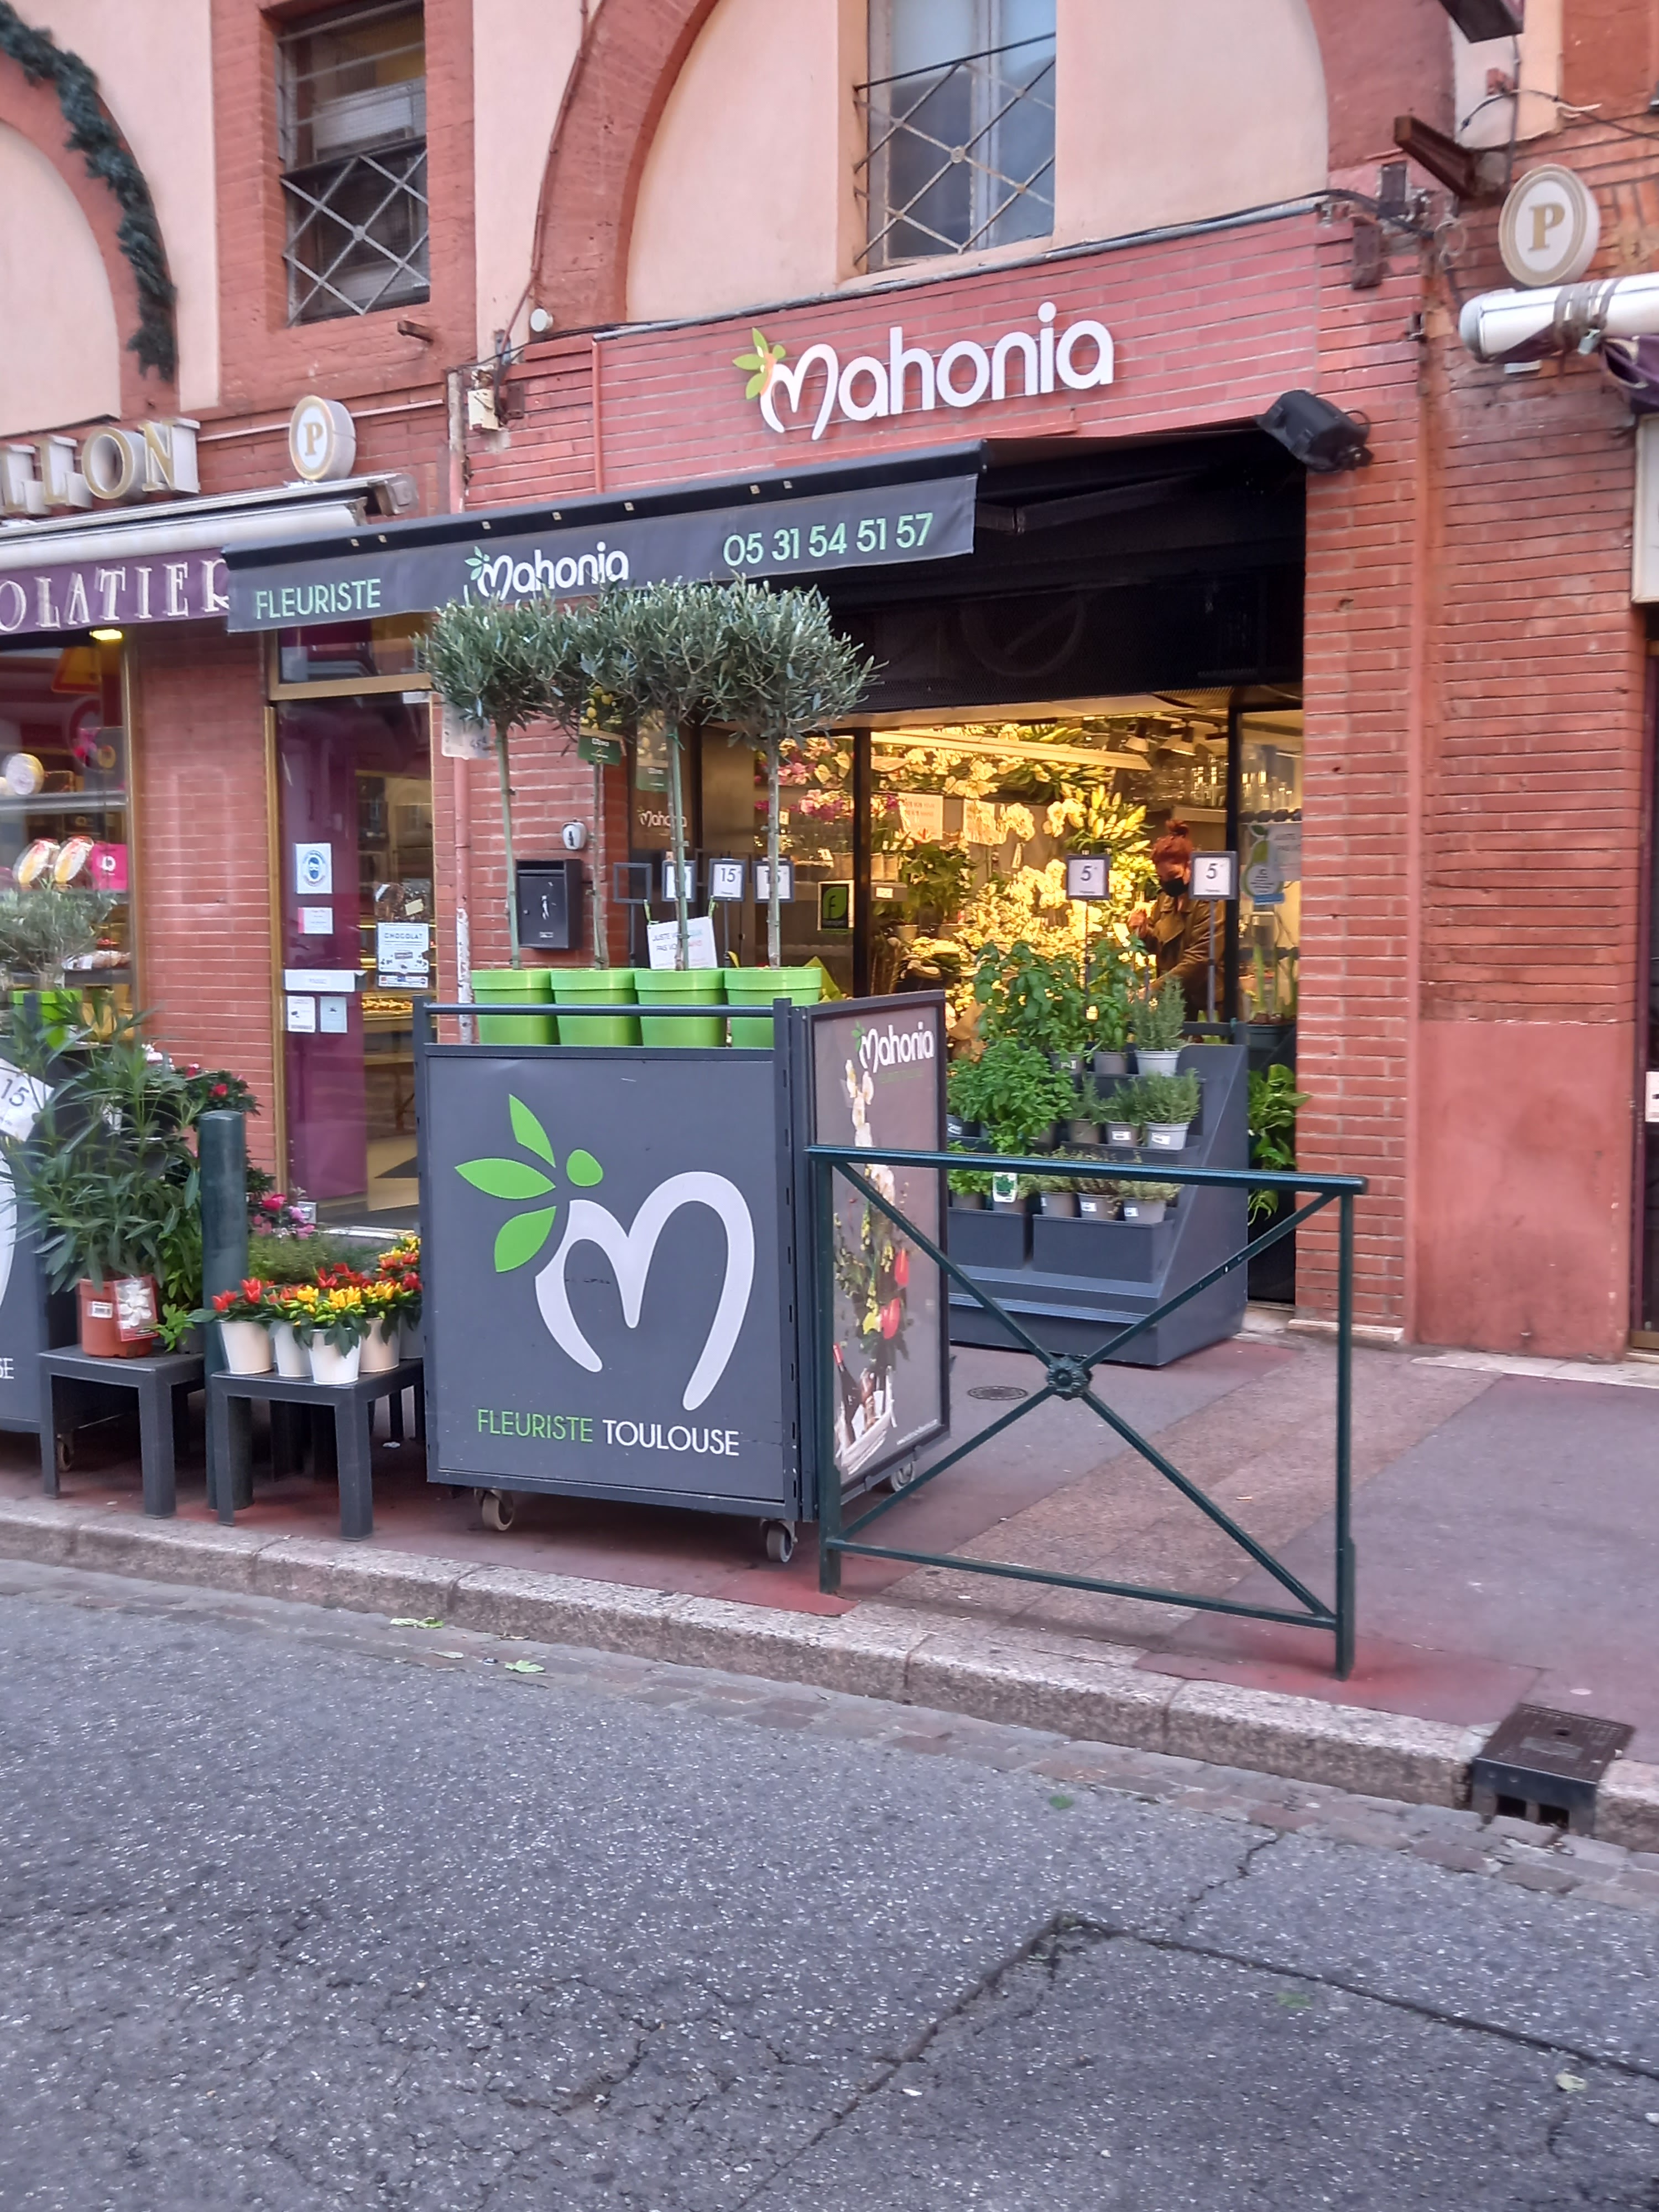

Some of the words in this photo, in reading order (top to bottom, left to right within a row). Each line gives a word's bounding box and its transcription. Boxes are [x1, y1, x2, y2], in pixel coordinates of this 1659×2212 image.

[1528, 202, 1566, 252] P
[760, 301, 1114, 441] Mahonia
[305, 422, 324, 456] P
[723, 532, 764, 567] 05
[771, 528, 800, 561] 31
[808, 522, 848, 558] 54
[855, 518, 886, 552] 51
[895, 512, 933, 549] 57
[477, 541, 629, 601] Mahonia
[255, 578, 381, 620] FLEURISTE
[721, 867, 737, 883] 15
[384, 932, 424, 940] CHOCOLAT
[859, 1021, 935, 1073] Mahonia
[1, 1079, 29, 1107] 15
[477, 1408, 593, 1443] FLEURISTE
[602, 1418, 739, 1457] TOULOUSE
